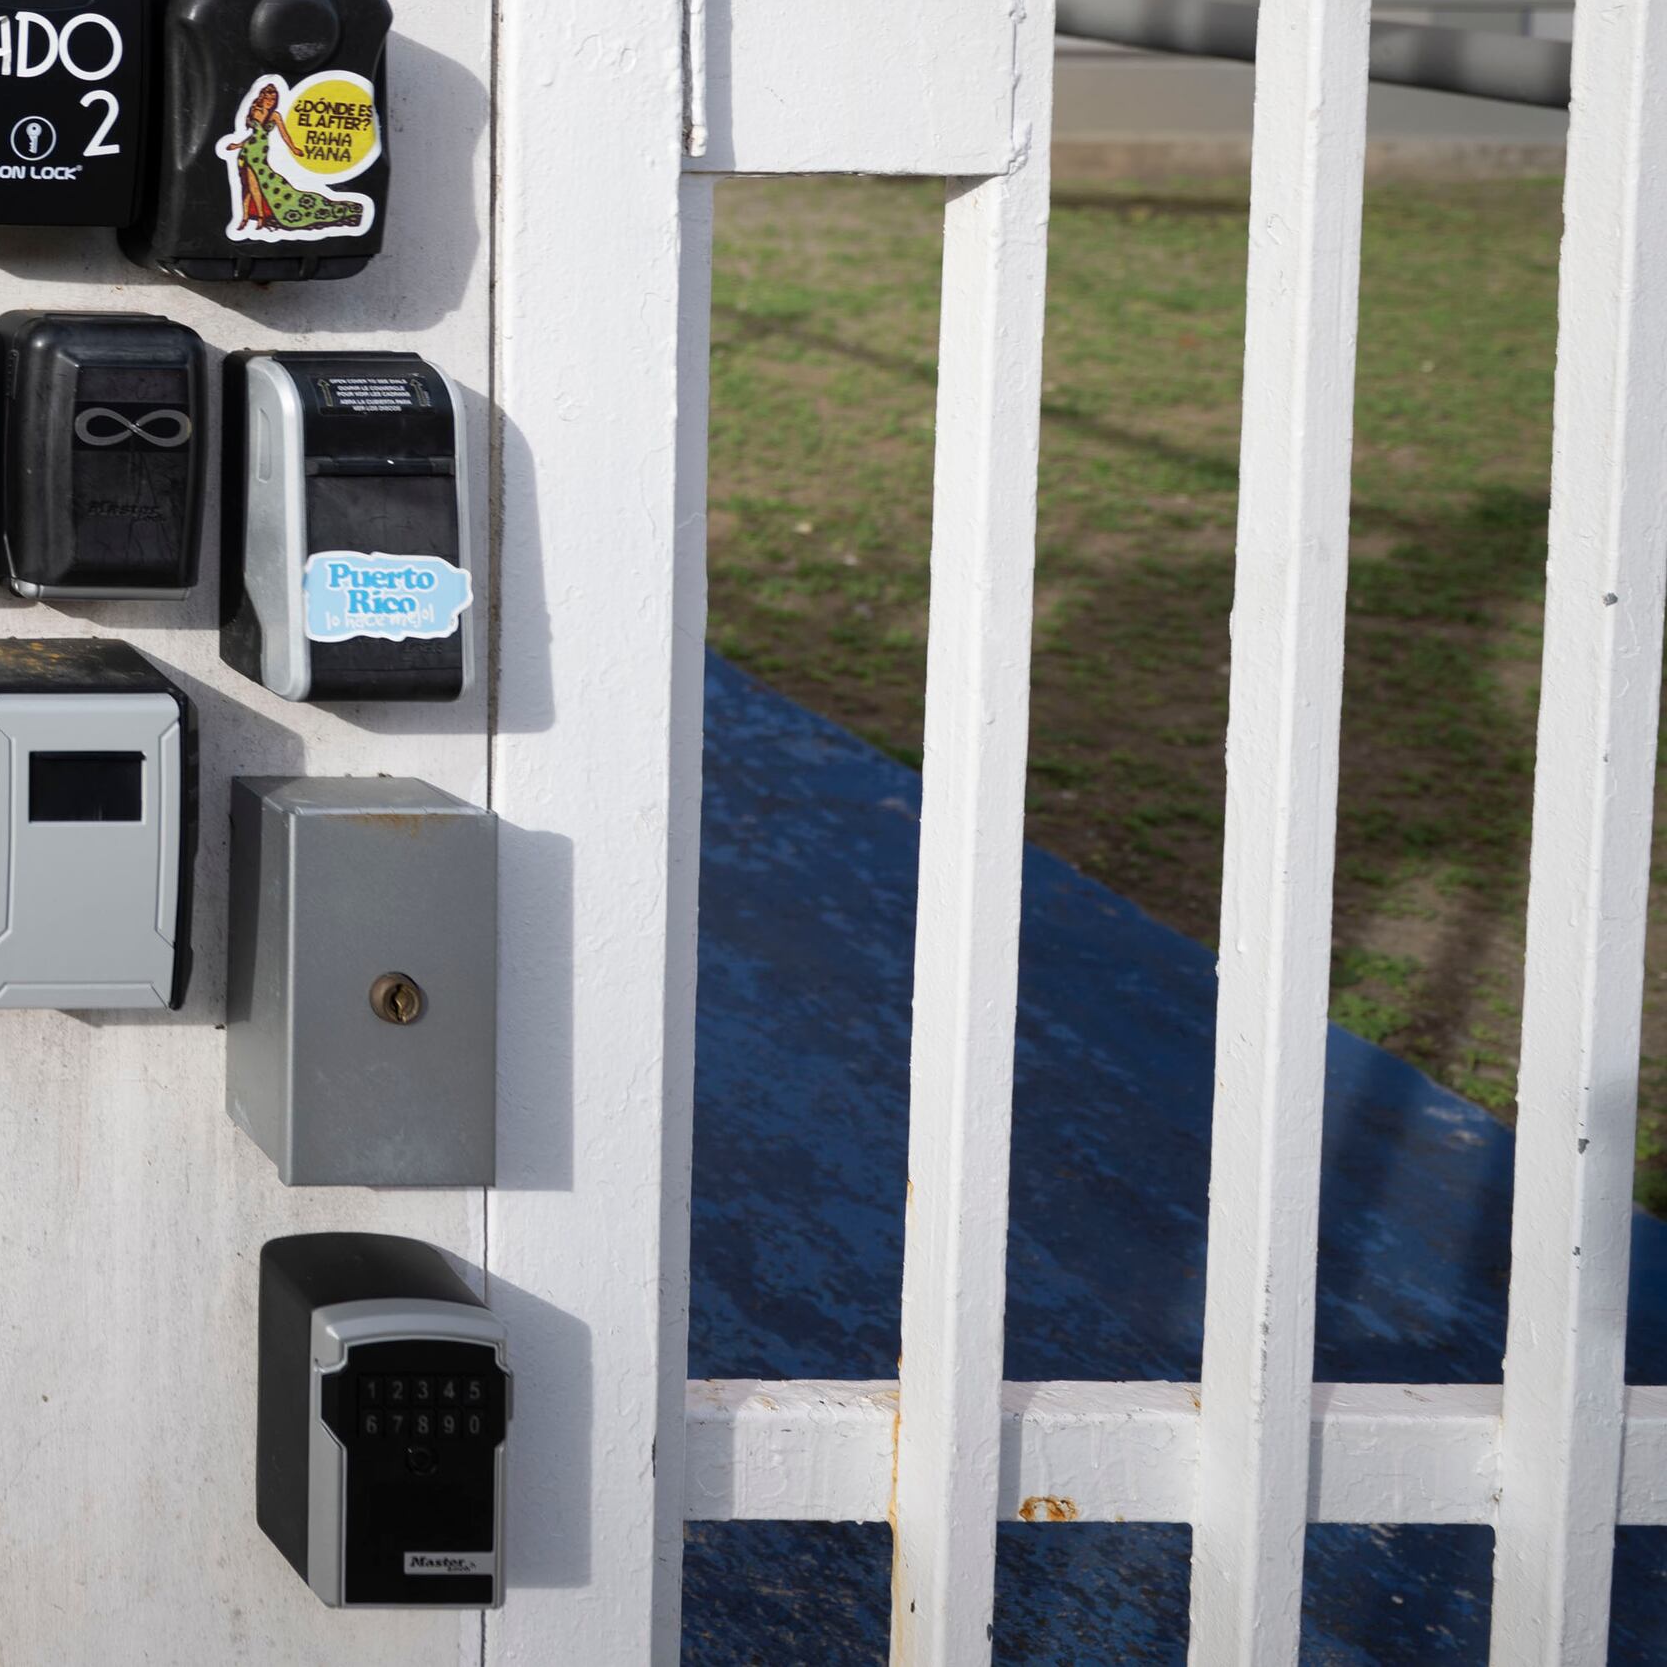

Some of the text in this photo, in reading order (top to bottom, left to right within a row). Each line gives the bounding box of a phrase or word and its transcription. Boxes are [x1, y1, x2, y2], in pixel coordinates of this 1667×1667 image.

[294, 97, 373, 118] ¿DÓNDE ES
[79, 89, 121, 158] 2
[297, 113, 371, 132] EL AFTER?
[304, 146, 351, 162] YANA
[30, 166, 77, 181] LOCK
[327, 563, 435, 590] Puerto
[347, 589, 417, 615] Rico
[368, 1381, 481, 1400] 1 2 3 4 5
[367, 1416, 480, 1434] 6 7 8 9 0
[409, 1555, 465, 1568] Master
